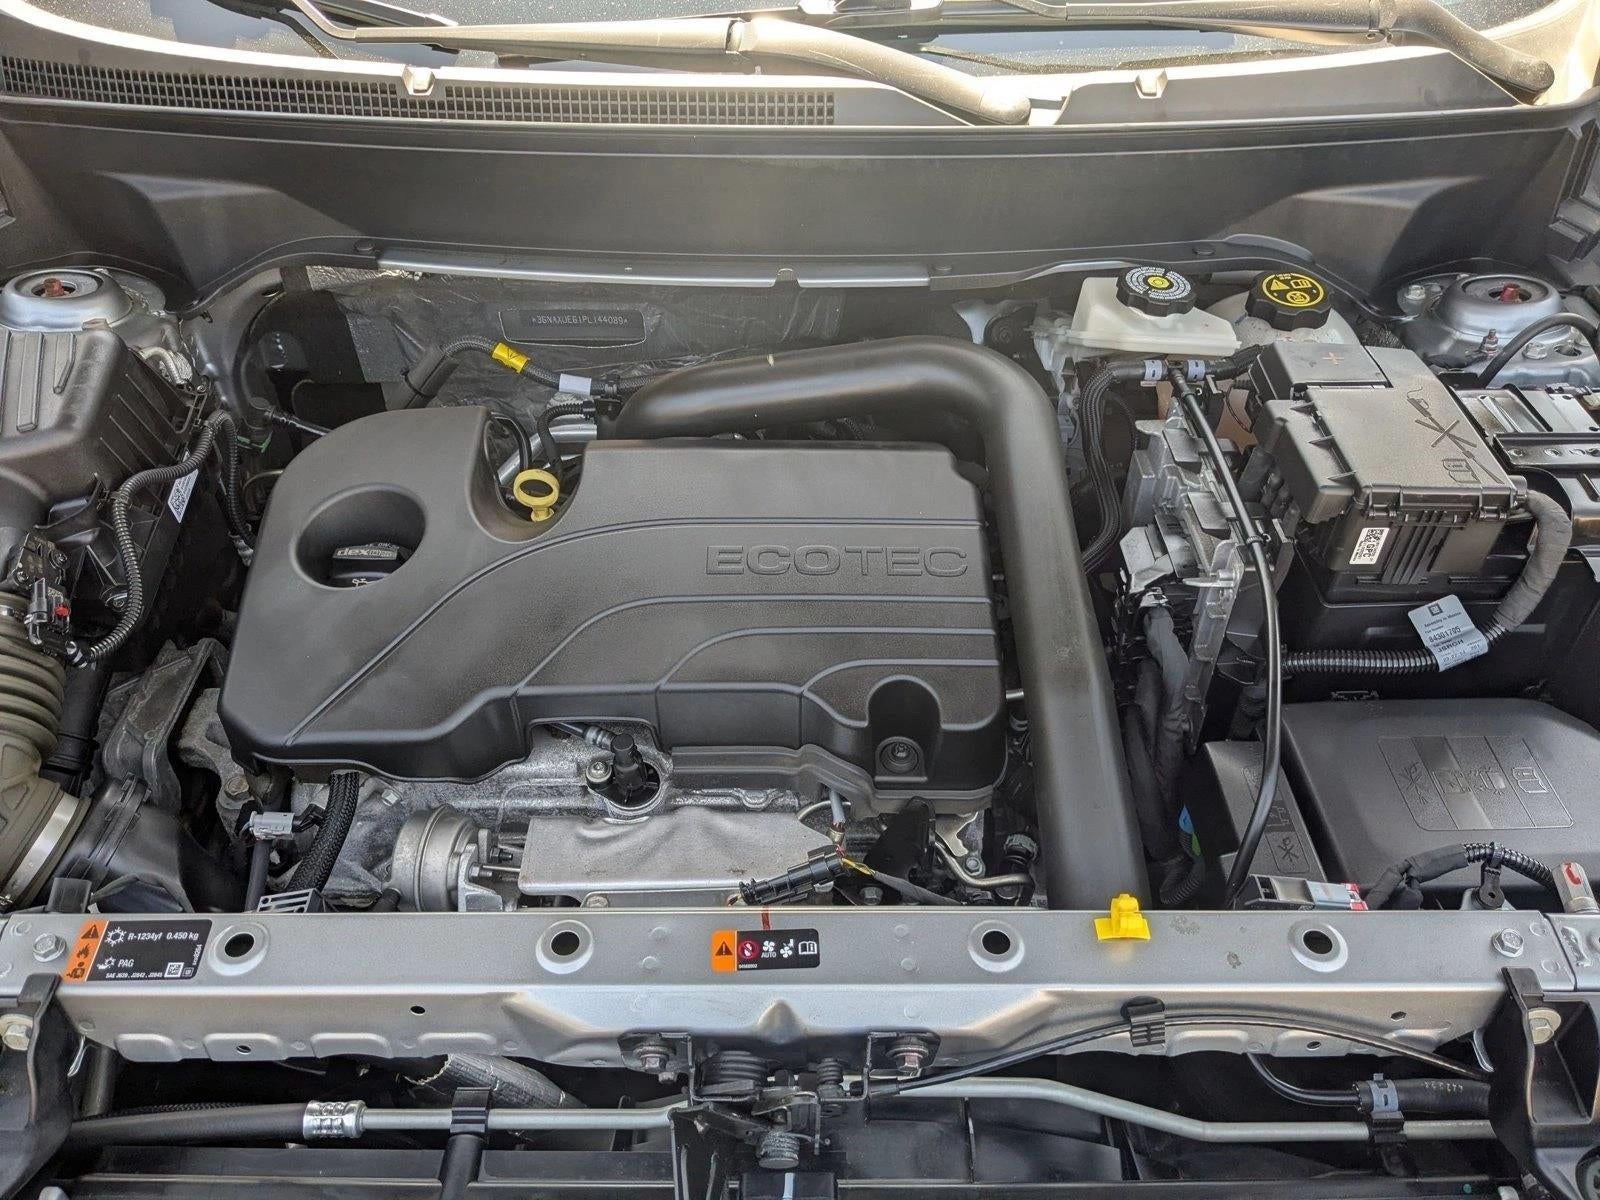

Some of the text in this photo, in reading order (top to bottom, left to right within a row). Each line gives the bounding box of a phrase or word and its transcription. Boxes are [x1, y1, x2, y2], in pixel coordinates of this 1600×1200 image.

[705, 544, 969, 578] ECOTEC
[127, 932, 200, 942] R-1234yf 0.450 kg
[117, 959, 135, 968] PAG
